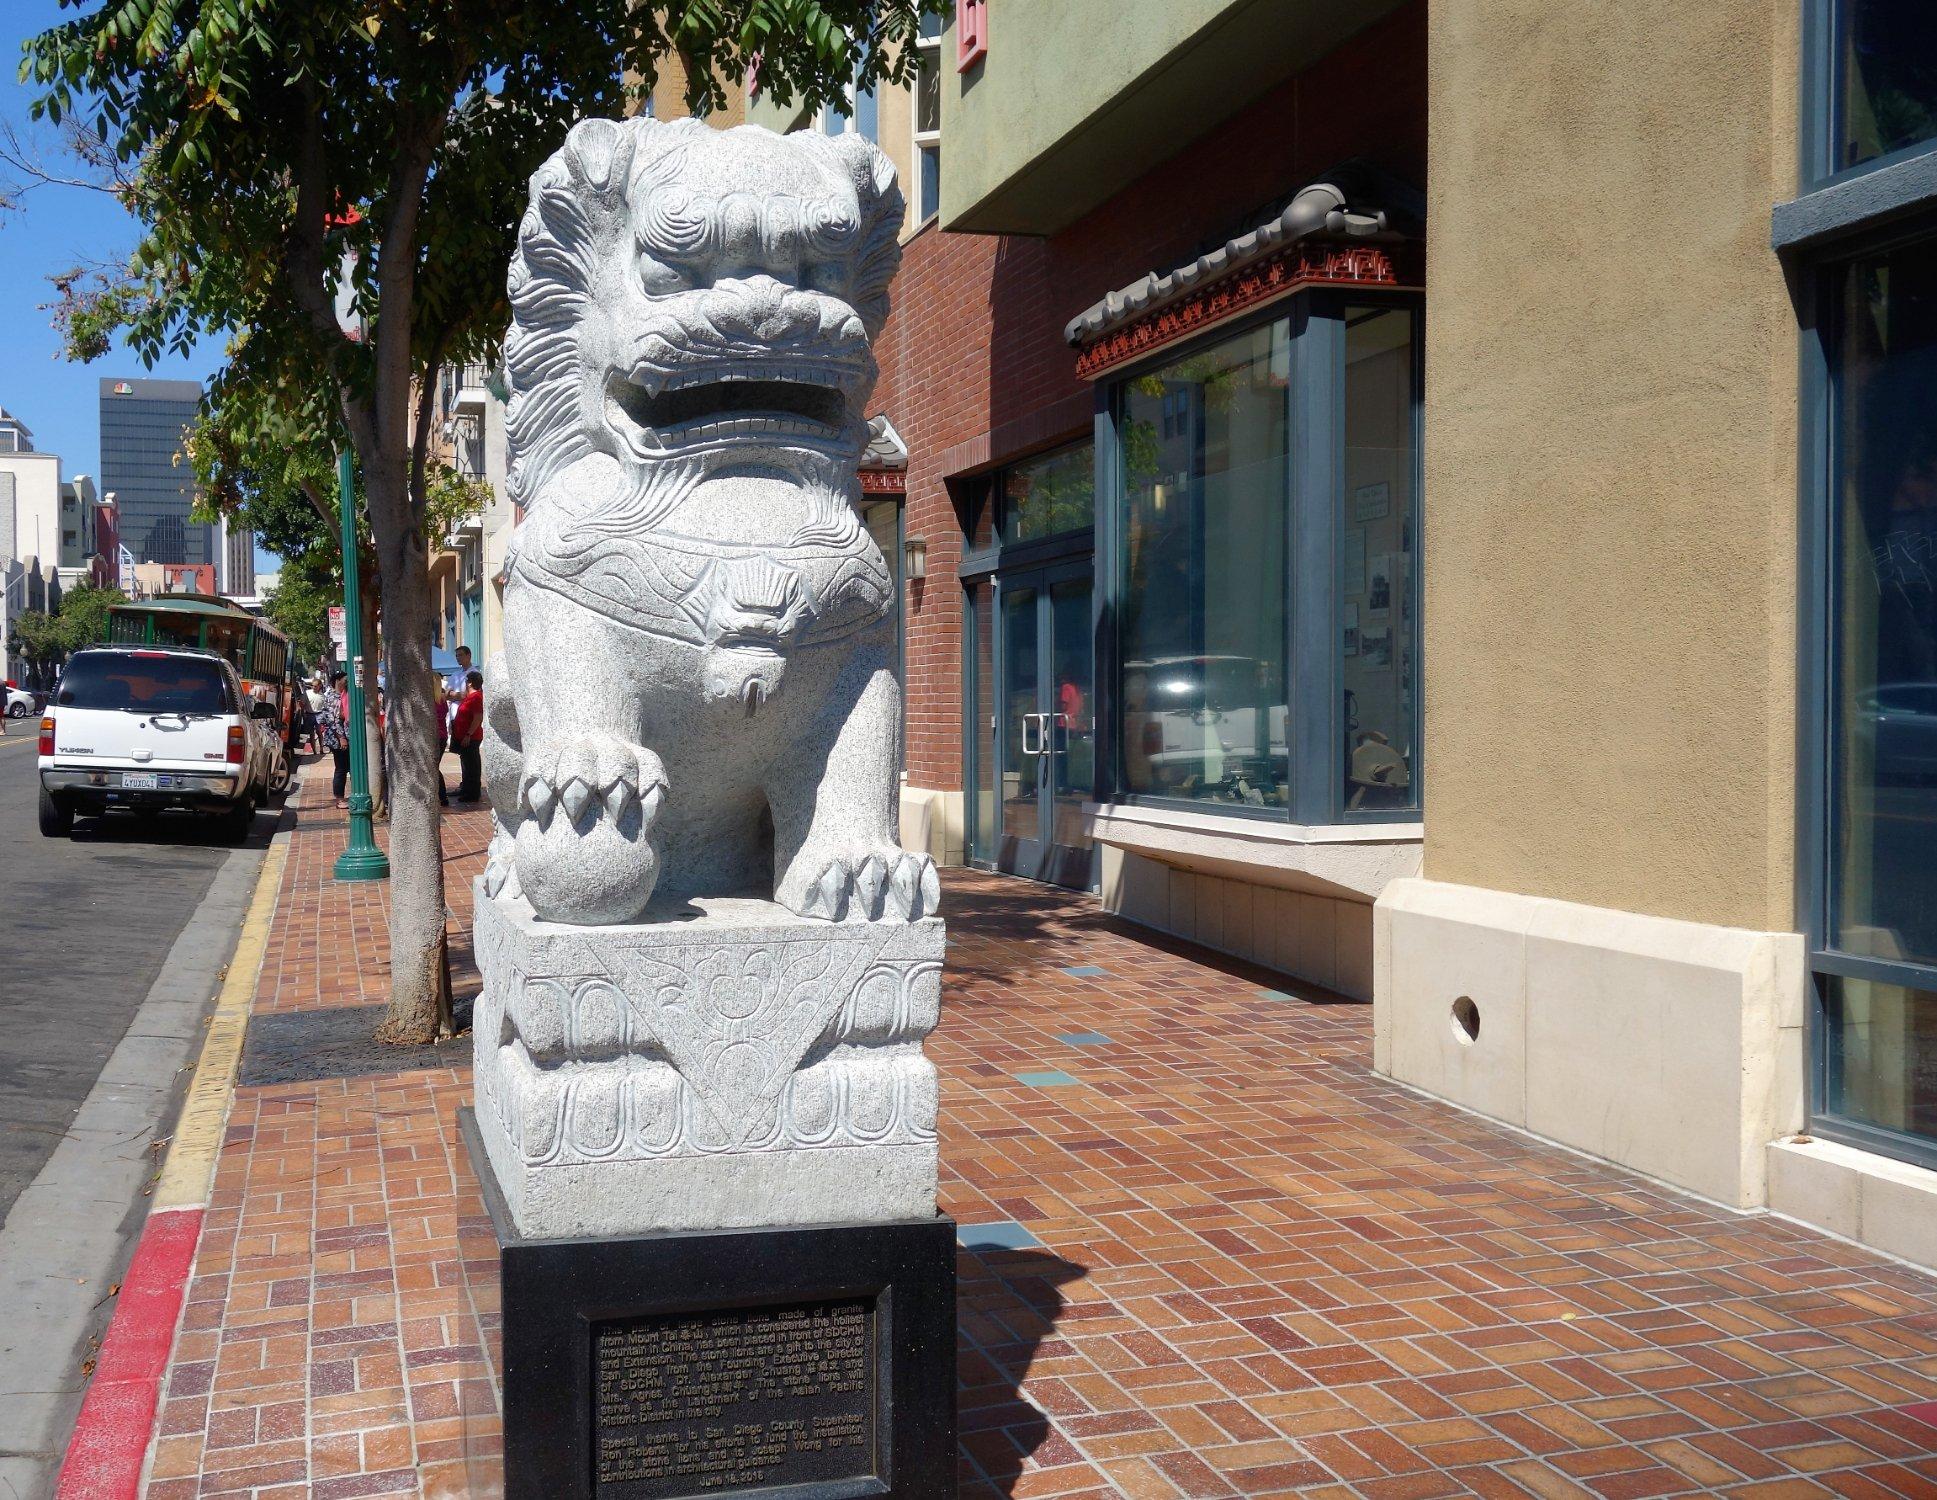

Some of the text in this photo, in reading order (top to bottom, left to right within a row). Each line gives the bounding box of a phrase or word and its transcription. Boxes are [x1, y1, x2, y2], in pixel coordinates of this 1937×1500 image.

[779, 1311, 805, 1320] made
[814, 1309, 823, 1317] of
[831, 1306, 864, 1318] granite
[600, 1336, 624, 1347] from
[629, 1332, 660, 1344] Mount
[713, 1325, 740, 1337] which
[746, 1324, 753, 1334] is
[758, 1319, 810, 1333] considered
[814, 1318, 829, 1328] the
[833, 1315, 864, 1326] holiest
[600, 1345, 646, 1358] mountain
[650, 1344, 660, 1354] in
[697, 1340, 714, 1350] has
[718, 1338, 740, 1348] been
[744, 1334, 775, 1348] placed
[777, 1333, 787, 1342] in
[789, 1331, 810, 1341] front
[814, 1329, 823, 1339] of
[600, 1358, 620, 1369] and
[680, 1352, 700, 1362] The
[701, 1351, 728, 1360] stone
[732, 1348, 754, 1358] lions
[756, 1347, 773, 1355] are
[786, 1342, 802, 1355] gift
[804, 1342, 814, 1351] to
[816, 1340, 832, 1350] the
[835, 1338, 851, 1349] city
[854, 1336, 864, 1346] of
[600, 1349, 864, 1380] San Diego from the Founding Executive Director
[600, 1382, 611, 1392] of
[700, 1369, 752, 1383] Alexander
[844, 1358, 864, 1369] and
[631, 1390, 662, 1402] Agnes
[755, 1378, 776, 1388] The
[783, 1376, 811, 1386] stone
[818, 1373, 841, 1382] lions
[848, 1369, 864, 1379] will
[600, 1380, 864, 1415] serve as the Landmark of the Asian Pacific
[600, 1414, 638, 1426] Historic
[639, 1410, 674, 1422] District
[687, 1407, 703, 1417] the
[600, 1414, 864, 1451] Special thanks to San Diego County Supervisor
[600, 1451, 621, 1460] Ron
[674, 1443, 689, 1453] for
[694, 1441, 710, 1450] his
[714, 1437, 745, 1448] efforts
[750, 1436, 761, 1444] to
[765, 1432, 787, 1443] fund
[792, 1430, 808, 1440] the
[600, 1434, 864, 1472] of the stone lions and to Joseph Wong for his
[600, 1469, 663, 1483] contributions
[666, 1466, 675, 1475] in
[677, 1459, 736, 1474] architectural
[699, 1477, 723, 1487] June
